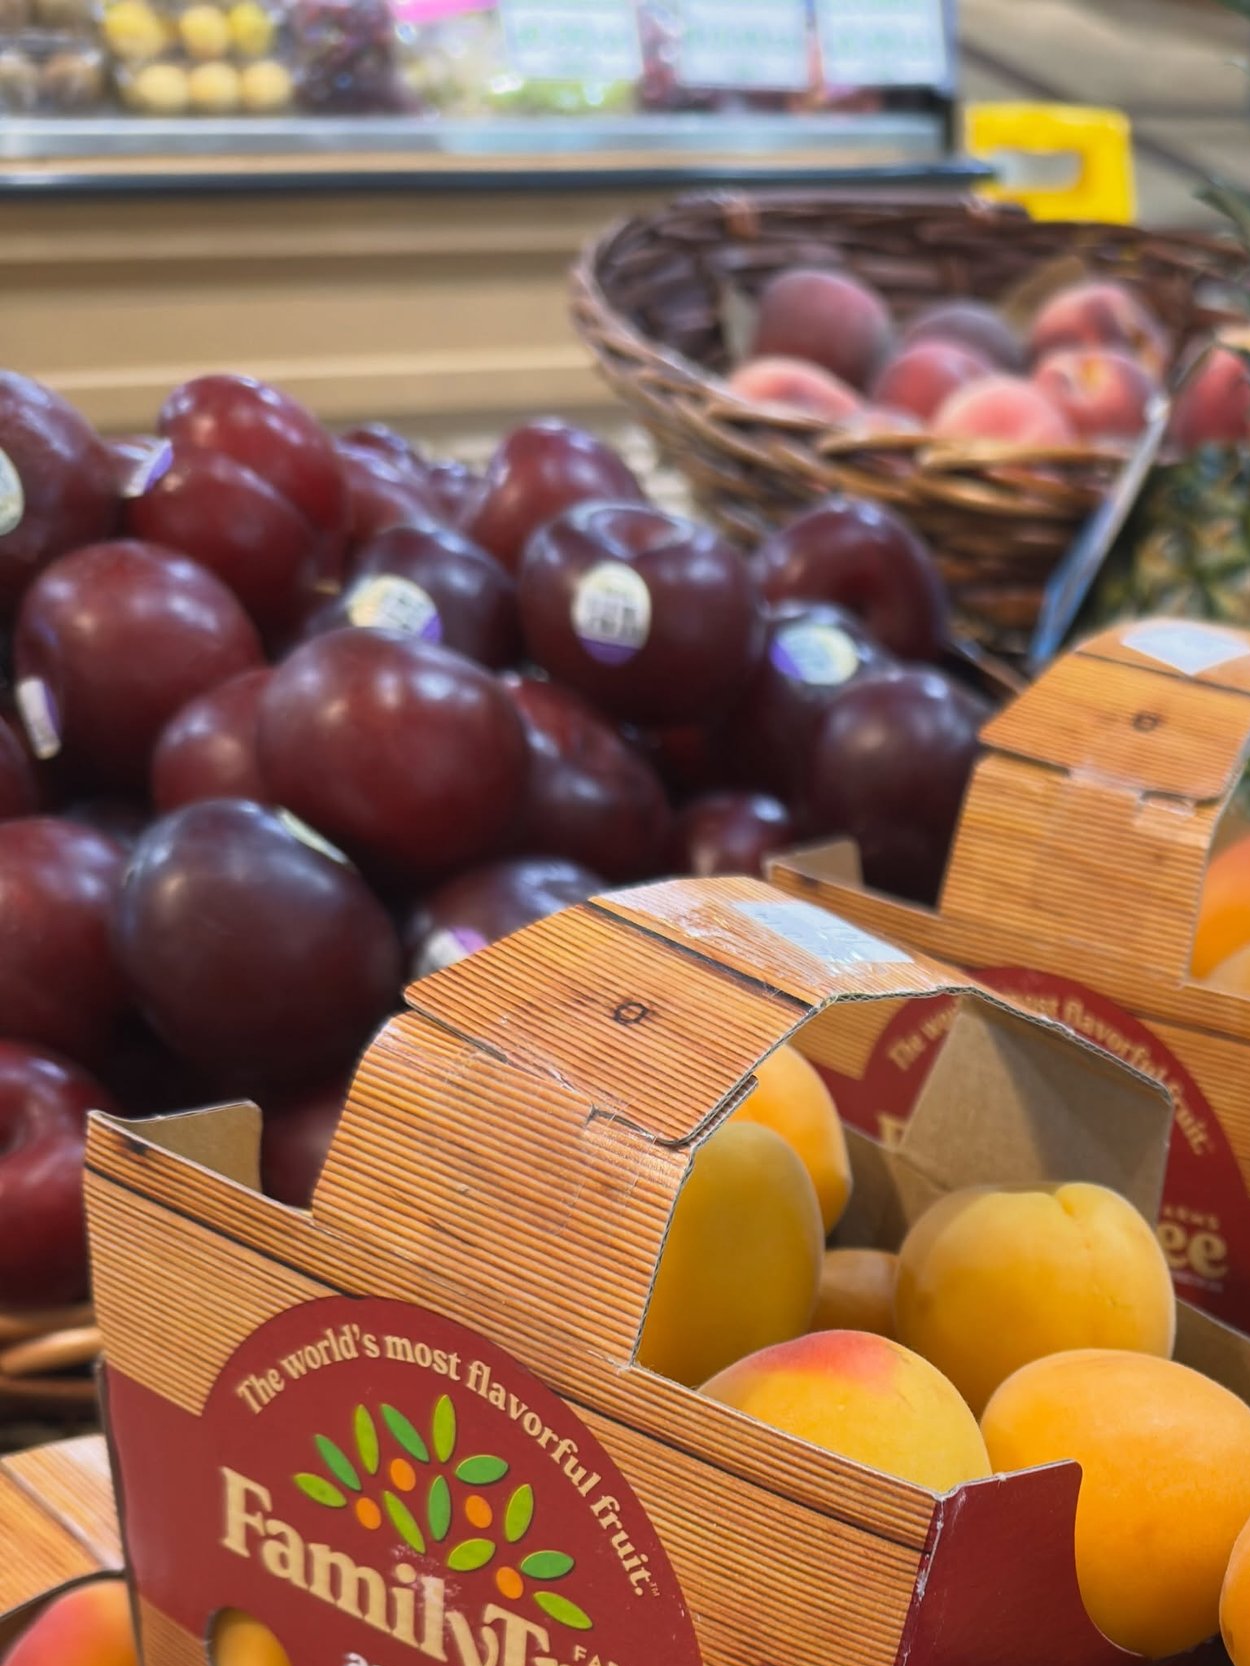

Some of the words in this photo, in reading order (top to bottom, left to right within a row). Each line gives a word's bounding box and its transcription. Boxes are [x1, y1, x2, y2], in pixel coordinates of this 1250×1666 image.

[236, 1372, 286, 1414] The
[280, 1323, 381, 1380] world's
[384, 1334, 462, 1381] most
[466, 1360, 602, 1498] flavorful
